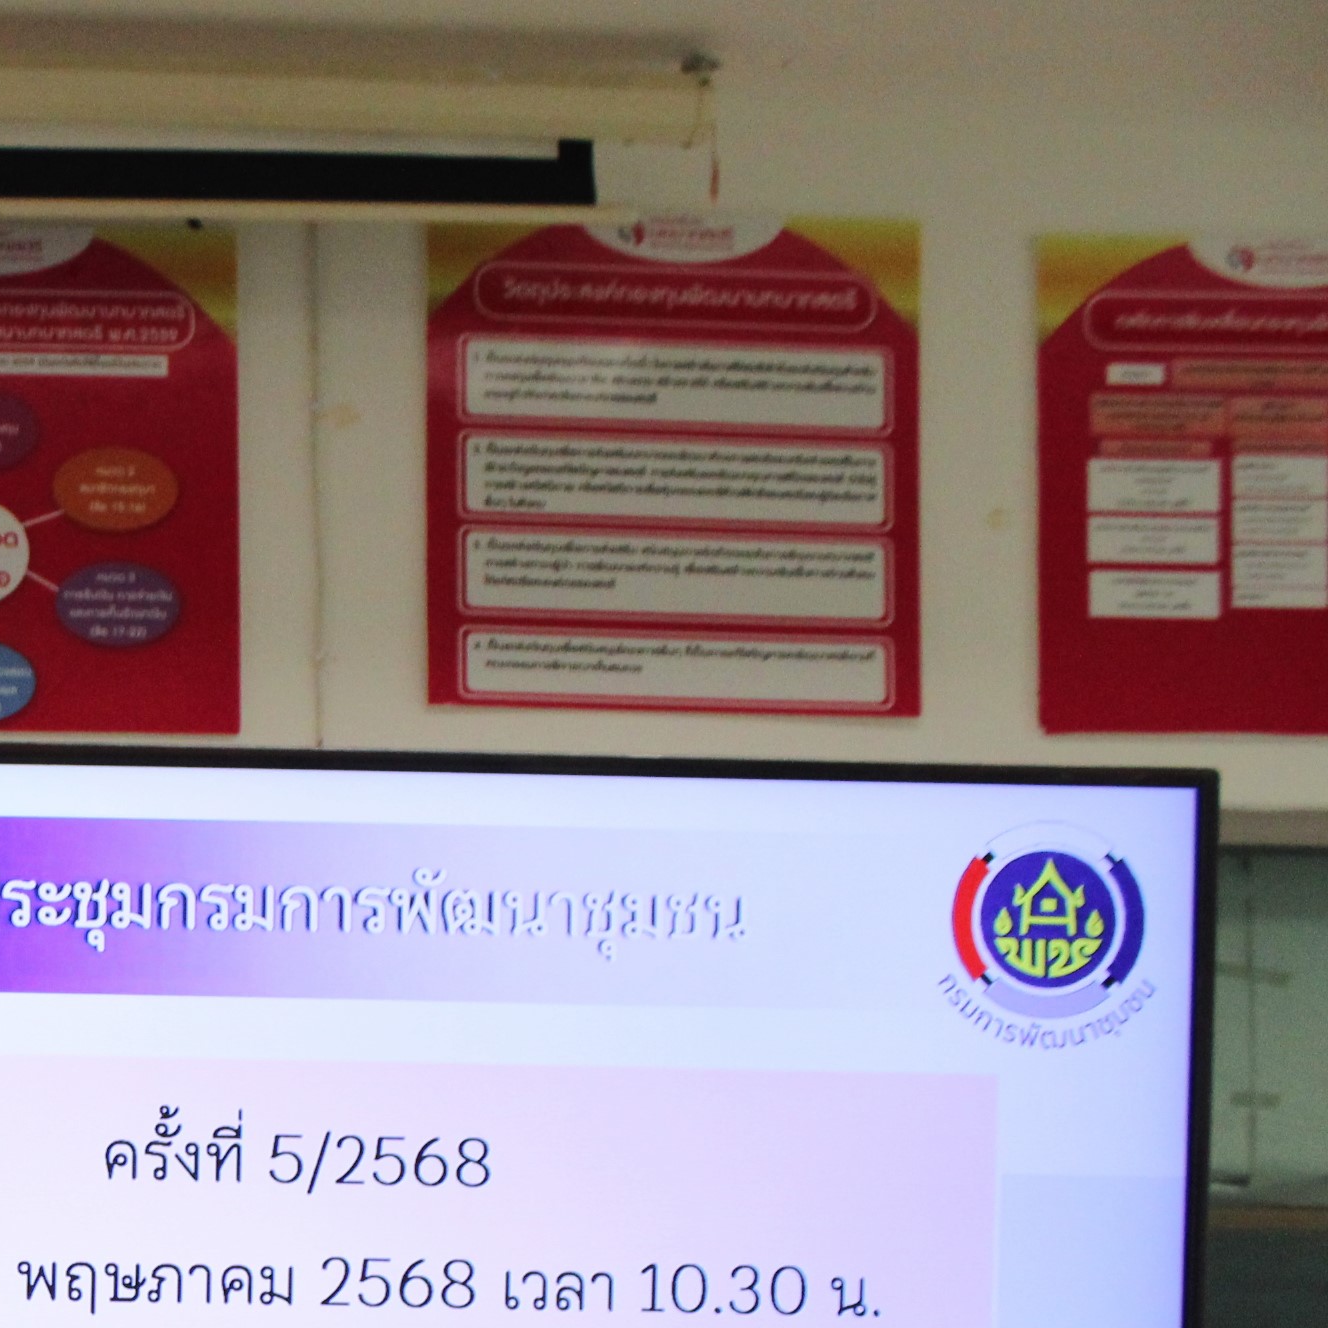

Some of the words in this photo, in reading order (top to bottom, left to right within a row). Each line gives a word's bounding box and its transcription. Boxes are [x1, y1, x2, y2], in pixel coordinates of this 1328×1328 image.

[105, 1105, 242, 1182] ครั้งที่
[269, 1131, 491, 1194] 5/2568
[17, 1261, 293, 1314] พฤษภาคม
[321, 1257, 475, 1309] 2568
[505, 1271, 614, 1311] เวลา
[641, 1264, 807, 1315] 10.30
[831, 1277, 880, 1317] น.
